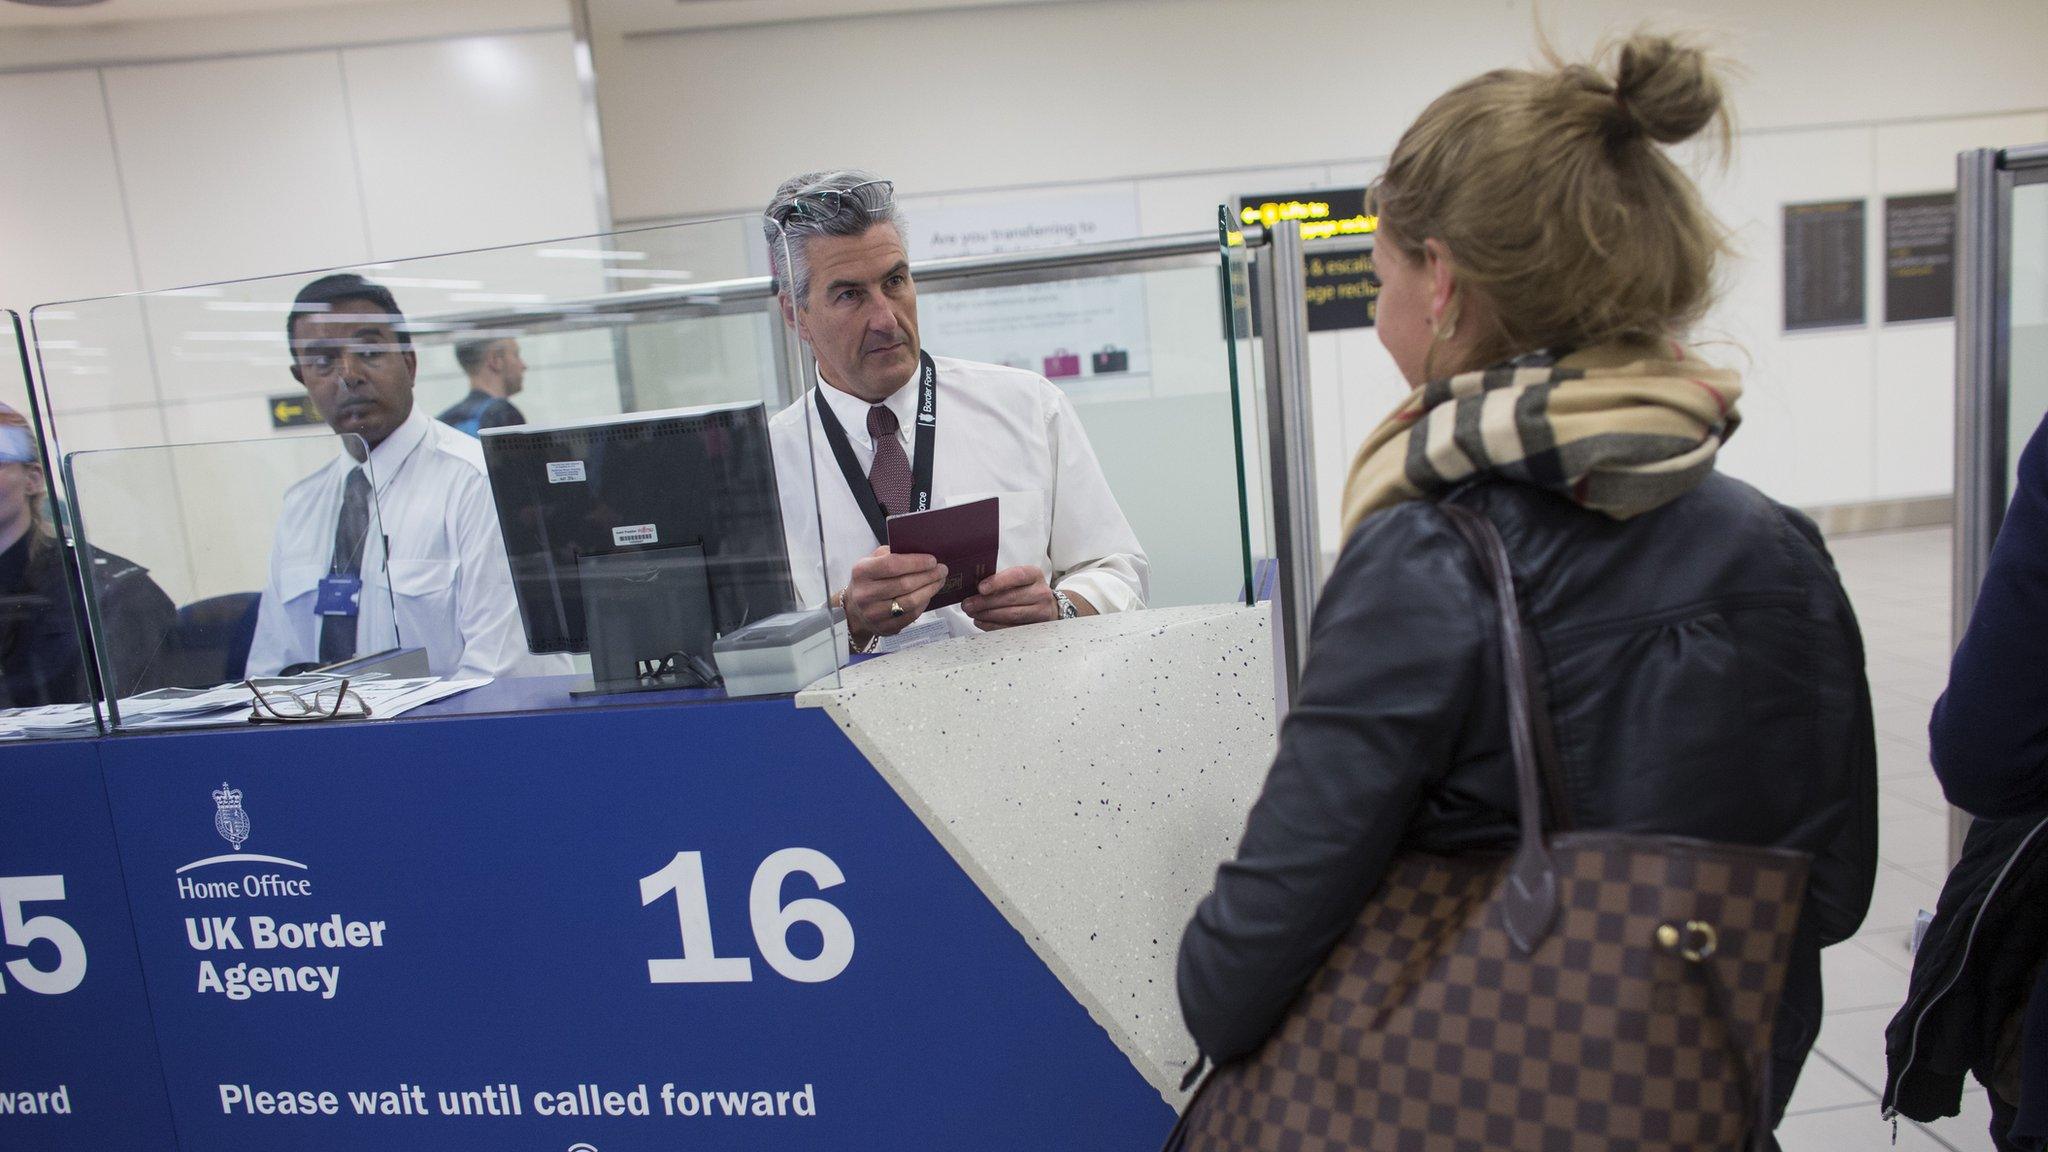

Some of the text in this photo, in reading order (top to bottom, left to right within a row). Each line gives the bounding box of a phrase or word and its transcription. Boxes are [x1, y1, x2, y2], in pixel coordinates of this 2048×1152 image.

[923, 366, 932, 412] Border Force
[917, 491, 927, 511] orce
[176, 874, 312, 900] Home Office
[0, 875, 87, 994] 5
[185, 914, 387, 951] UK Border
[639, 847, 856, 984] 16
[197, 960, 340, 1001] Agency
[219, 1083, 816, 1116] Please wait until called forward
